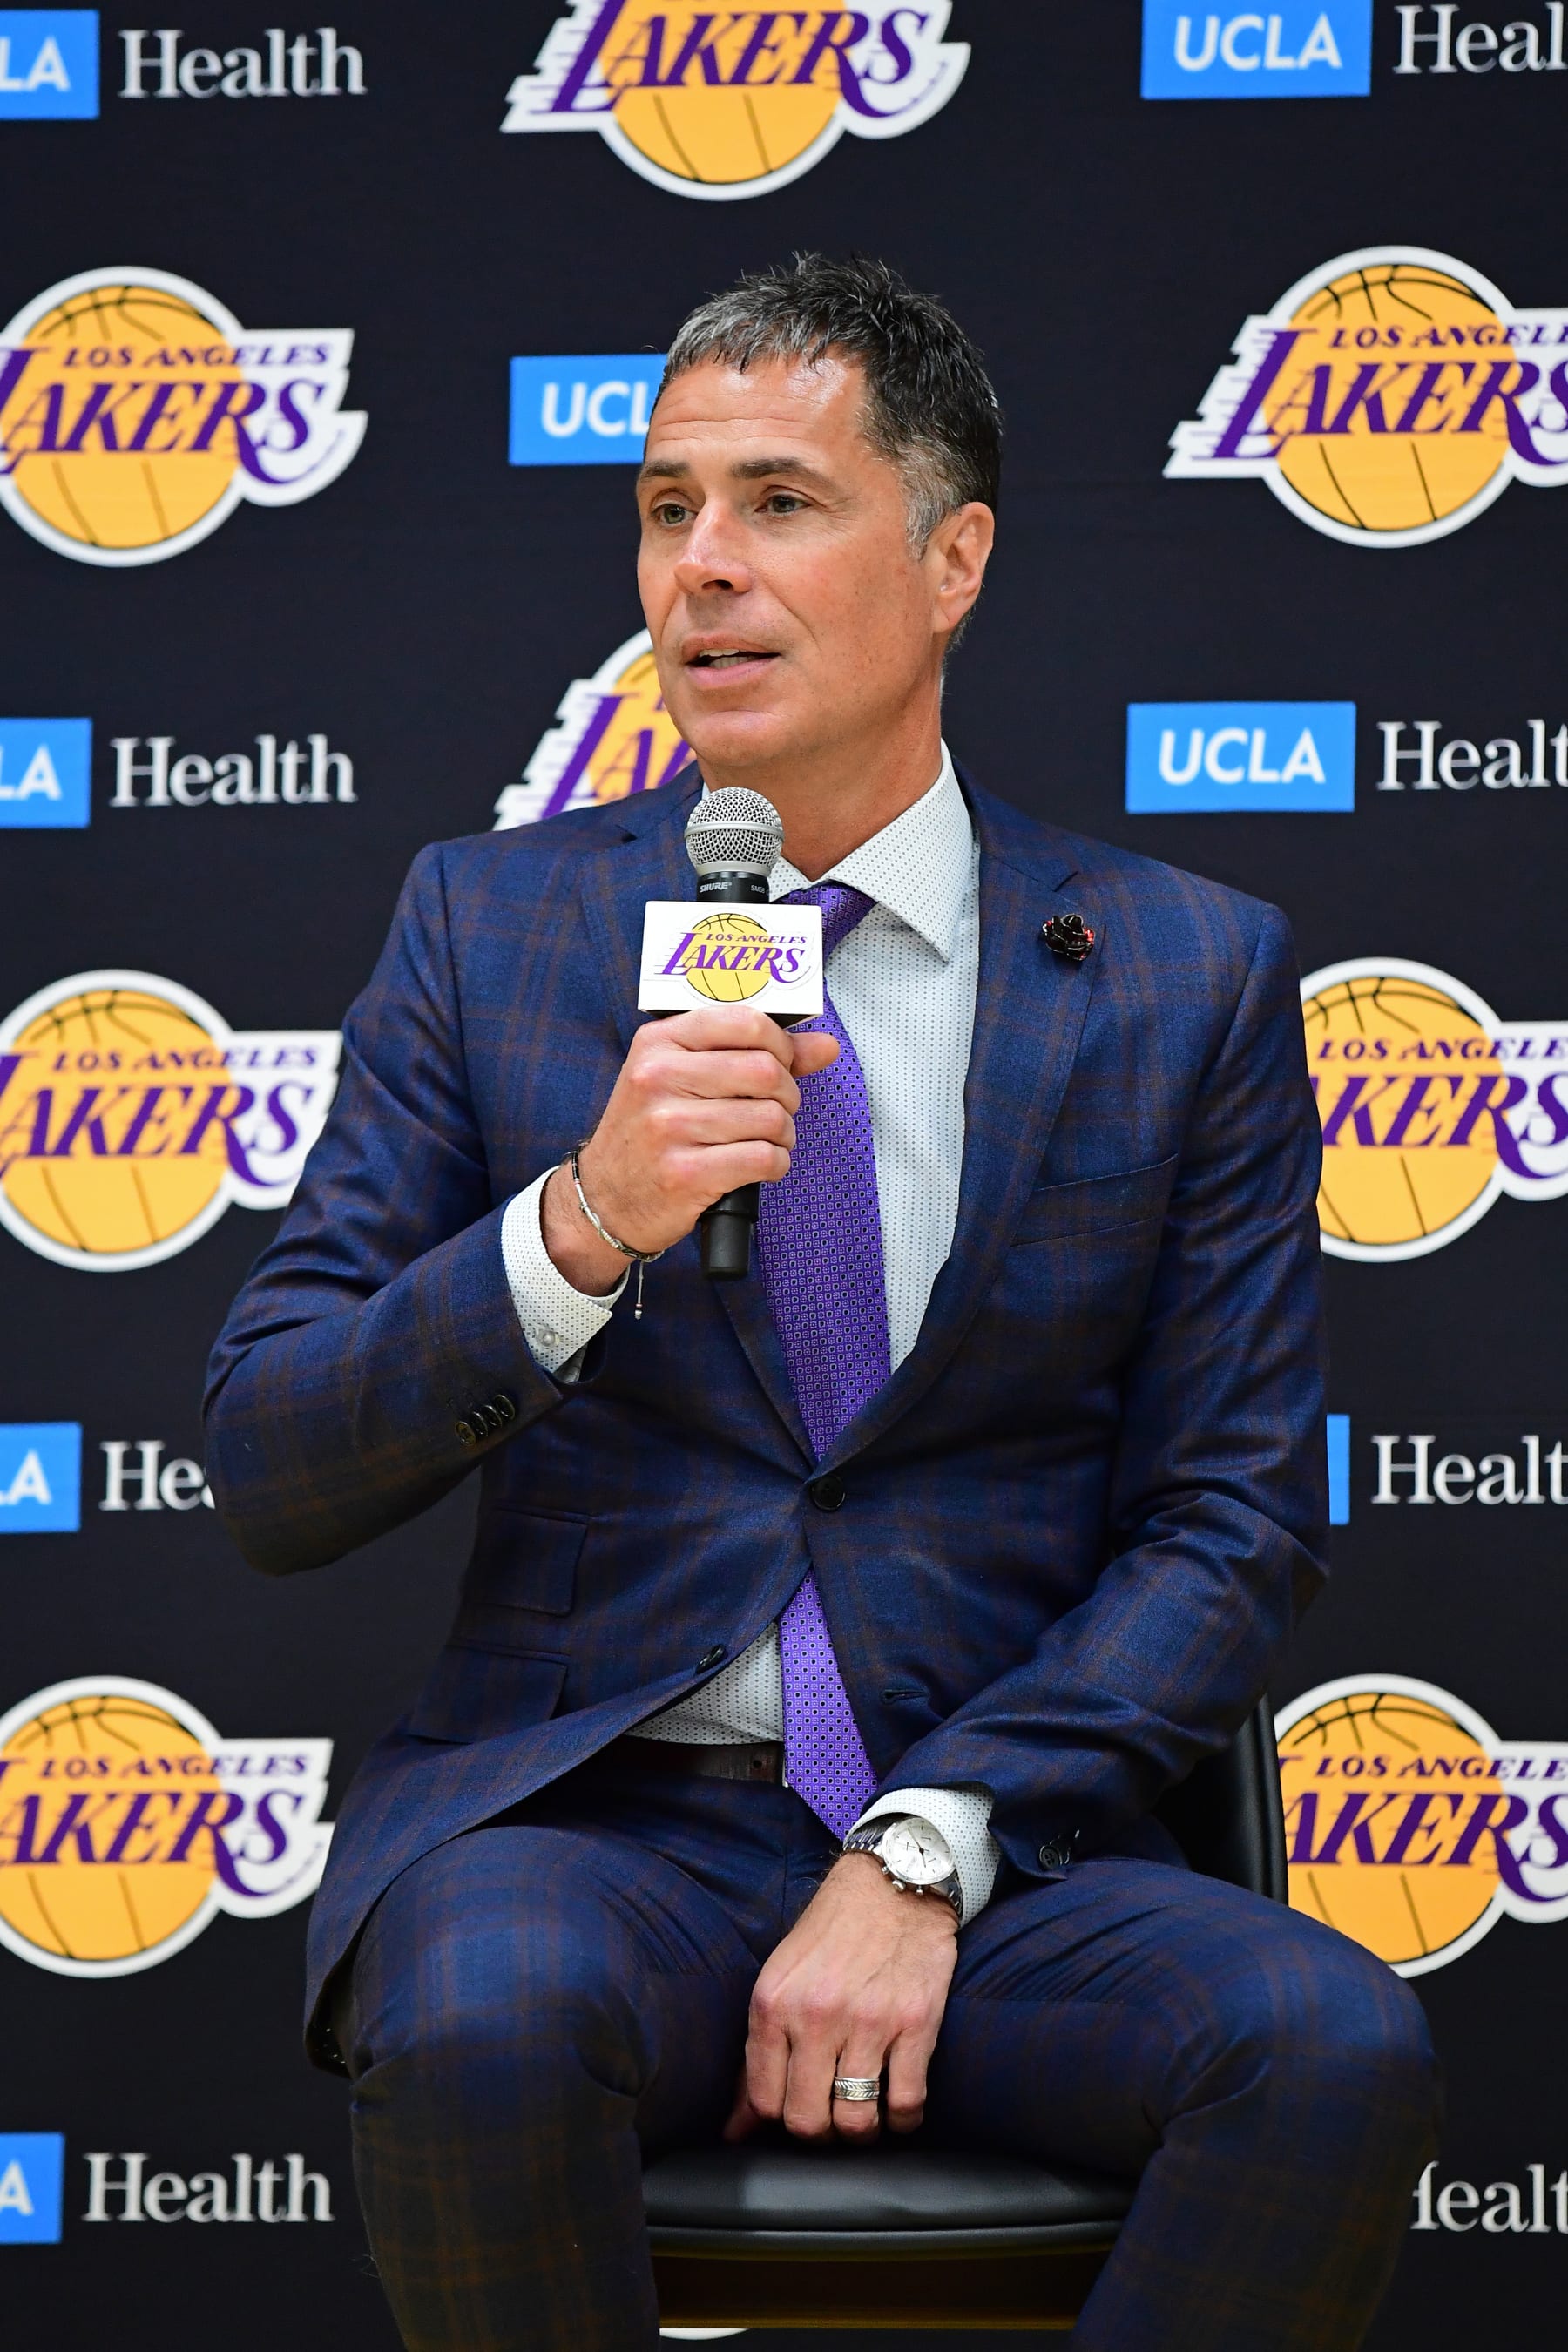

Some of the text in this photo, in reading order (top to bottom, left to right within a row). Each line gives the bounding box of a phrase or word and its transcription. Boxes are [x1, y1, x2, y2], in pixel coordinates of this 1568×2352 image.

[118, 27, 368, 98] Health
[528, 0, 947, 118] LAKERS
[1174, 1, 1567, 74] UCLA Heal
[63, 343, 332, 368] LOS ANGELES
[1329, 326, 1405, 348] LOS
[541, 381, 650, 438] UCL
[109, 734, 358, 808] Health
[1159, 719, 1568, 790] UCLA Healt
[654, 931, 812, 984] LAKERS
[735, 935, 807, 945] ANGELES
[52, 1048, 317, 1072] LOS ANGELES
[1318, 1037, 1568, 1061] LOS ANGELE
[0, 1056, 315, 1186] AKERS
[1308, 1071, 1568, 1180] KERS
[1370, 1435, 1568, 1505] Healt
[40, 1754, 308, 1778] LOS ANGELES
[1315, 1755, 1568, 1781] LOS ANGELE
[0, 1788, 324, 1897] AKERS
[1281, 1791, 1568, 1904] AKERS
[82, 2152, 335, 2223] Health
